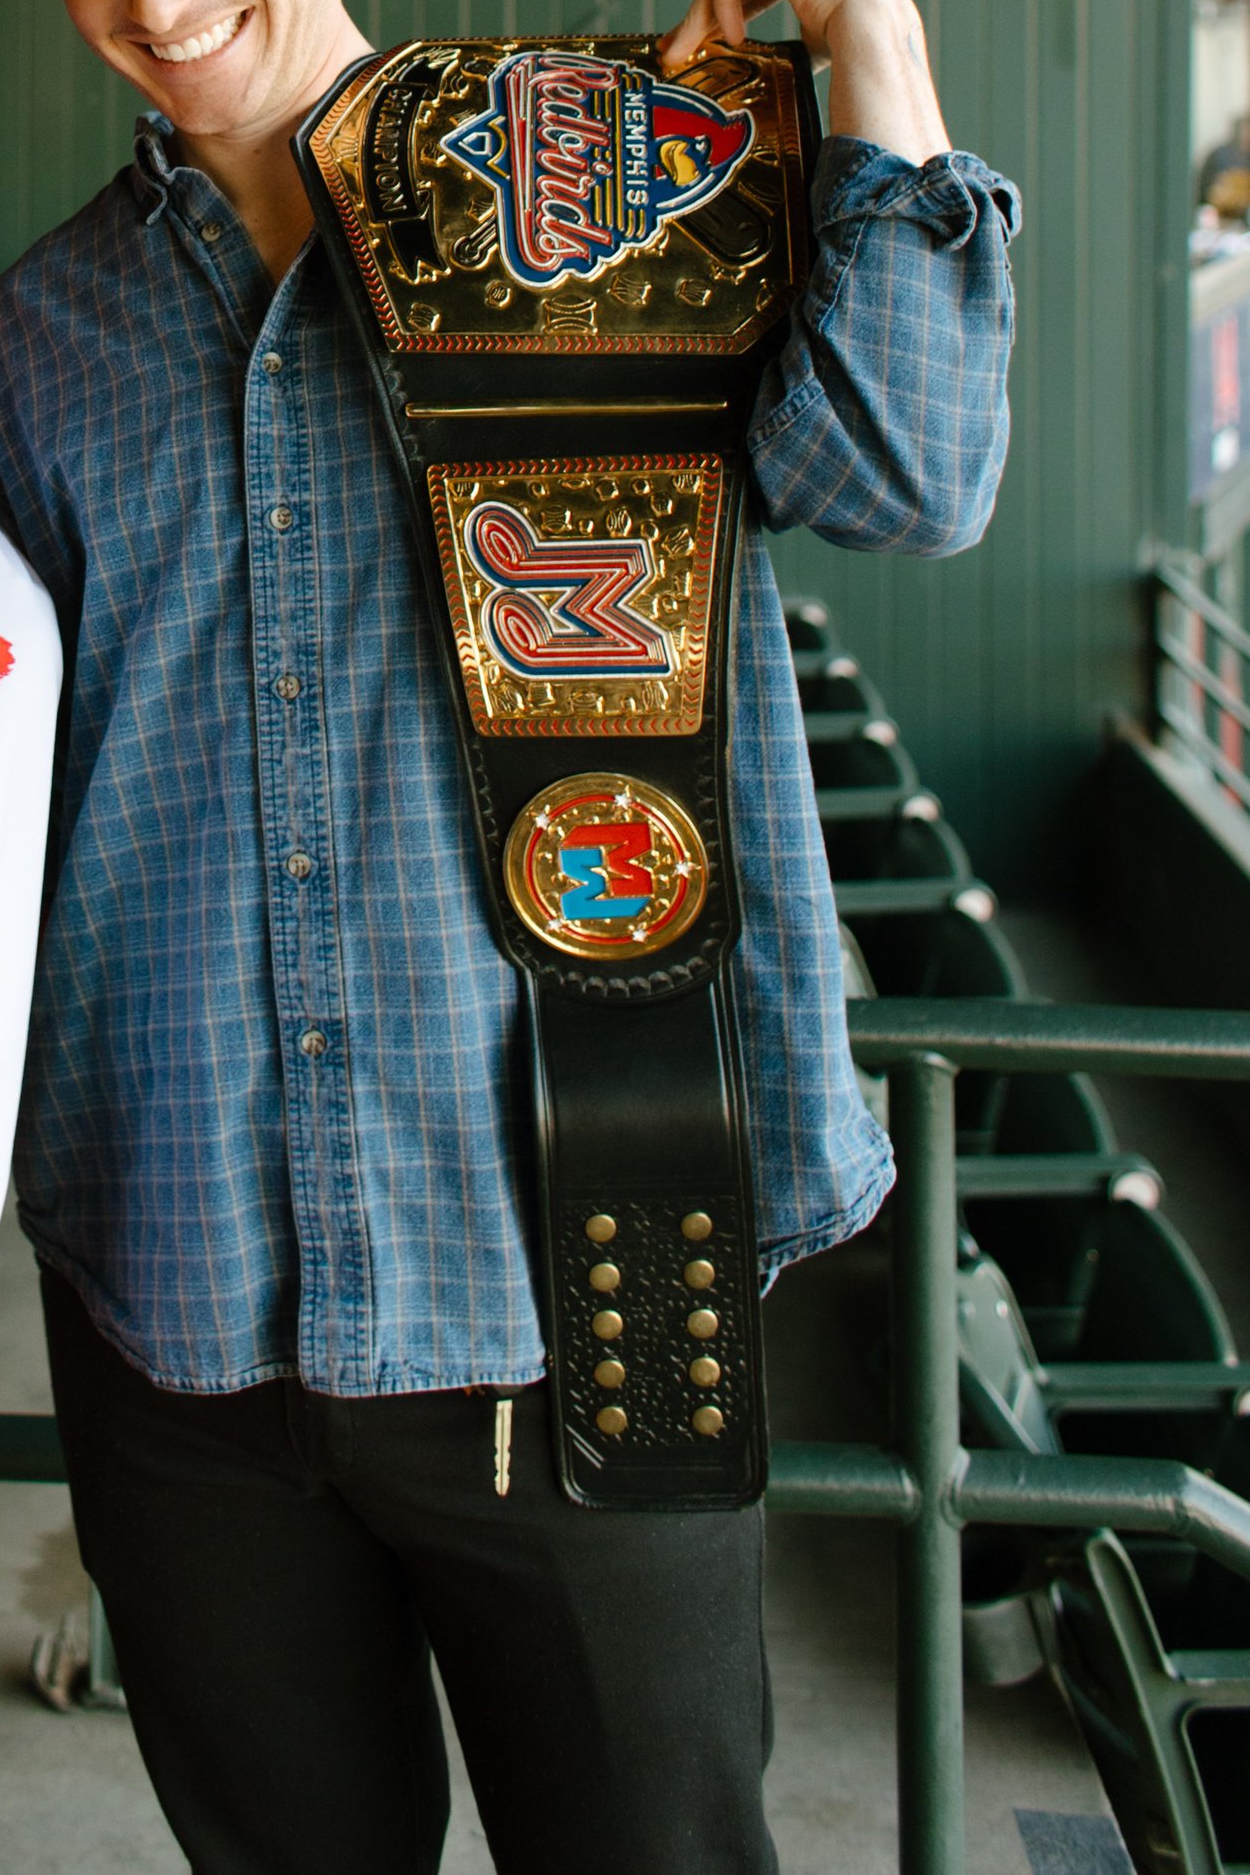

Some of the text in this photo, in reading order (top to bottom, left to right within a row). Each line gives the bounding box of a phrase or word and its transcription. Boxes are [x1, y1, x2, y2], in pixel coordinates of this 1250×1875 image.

[374, 88, 409, 212] CHAMPION
[534, 55, 620, 267] Redbirds
[624, 90, 650, 209] MEMPHIS
